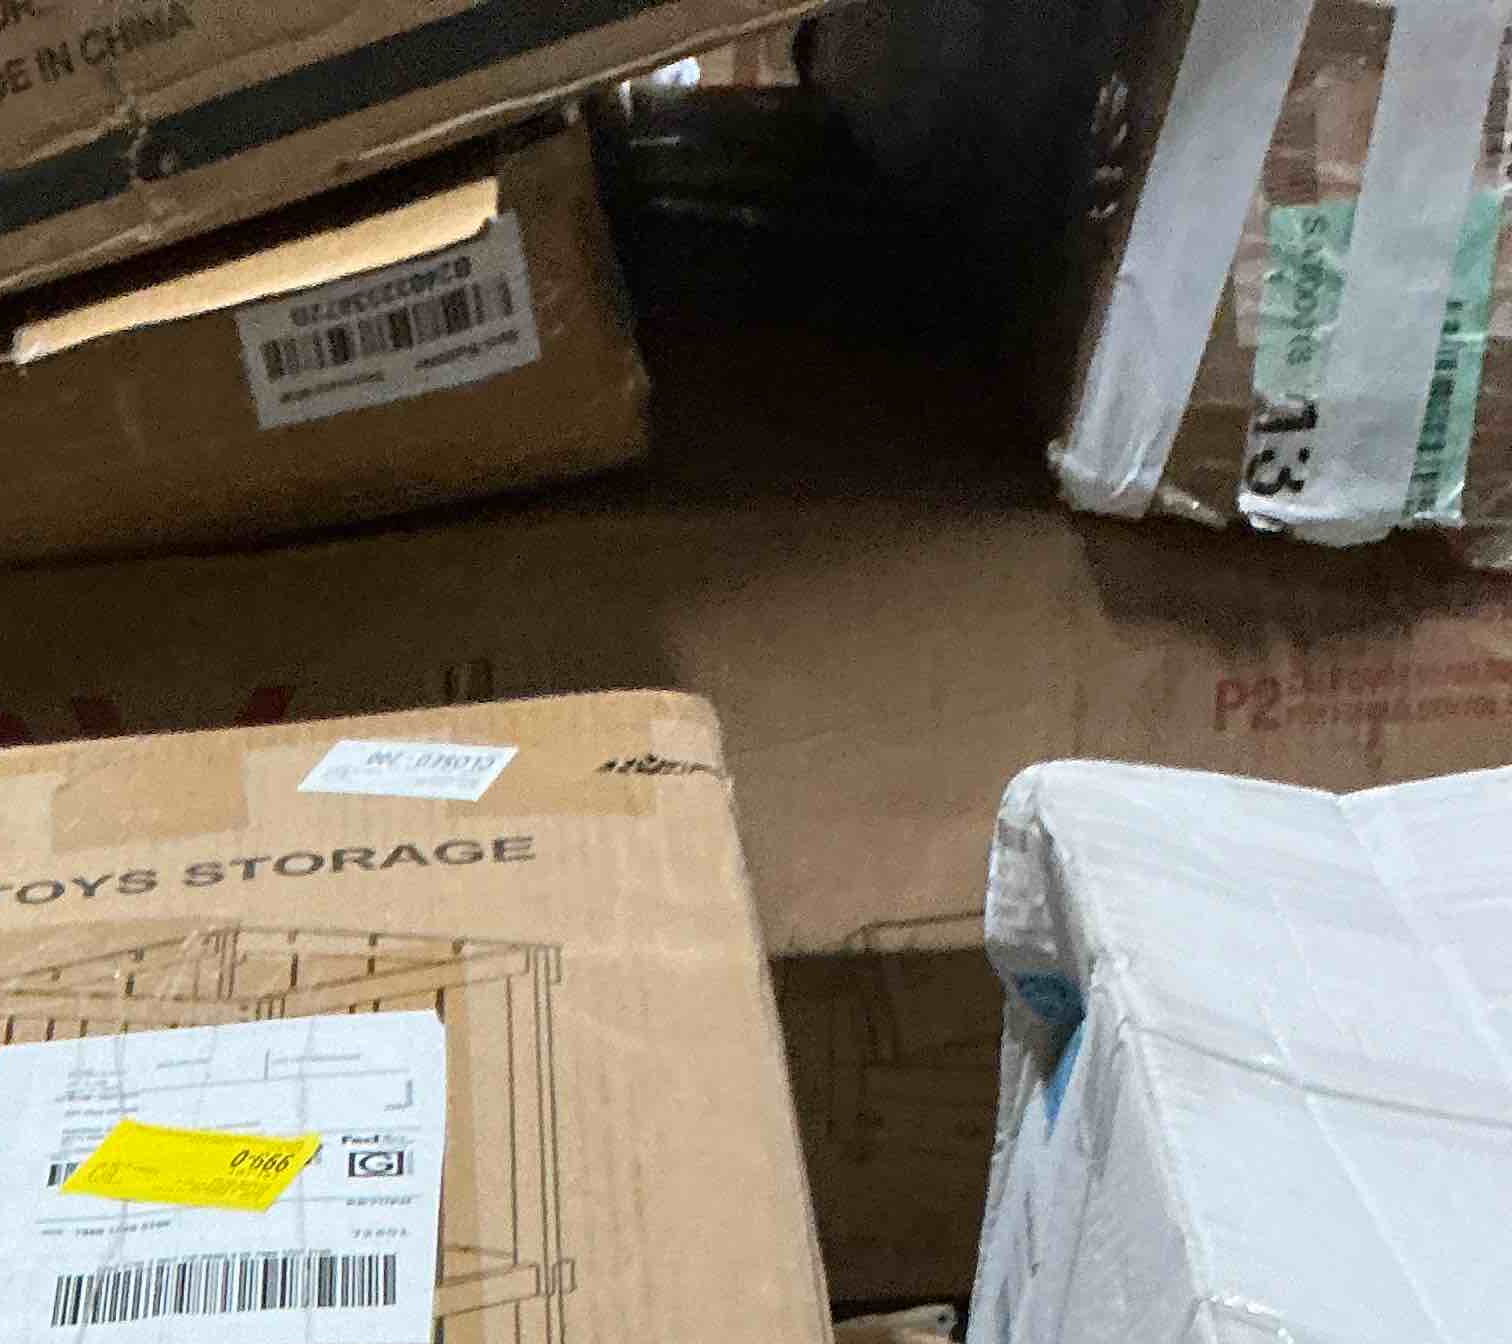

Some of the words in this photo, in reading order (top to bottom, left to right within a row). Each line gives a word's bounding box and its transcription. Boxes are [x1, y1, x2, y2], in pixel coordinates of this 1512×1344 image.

[34, 41, 74, 84] IN
[80, 0, 194, 65] CHINA
[182, 835, 536, 888] STORAGE
[358, 1150, 394, 1174] G
